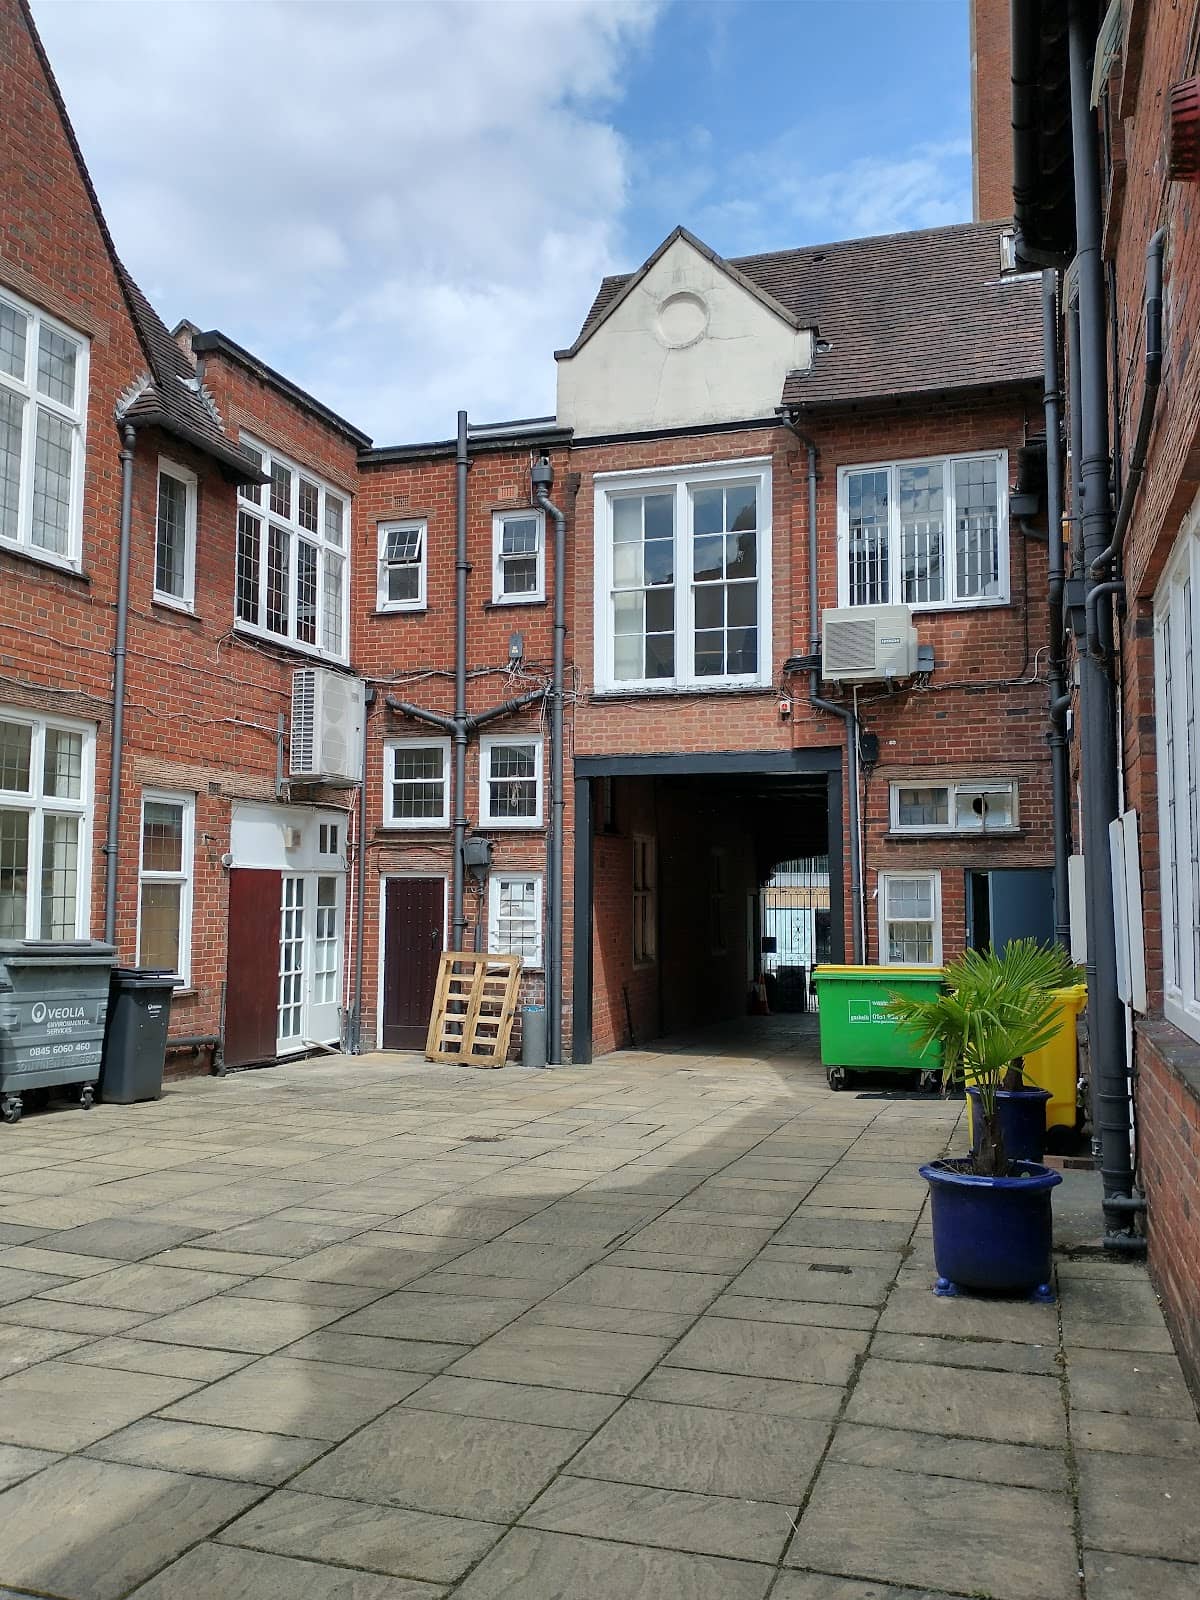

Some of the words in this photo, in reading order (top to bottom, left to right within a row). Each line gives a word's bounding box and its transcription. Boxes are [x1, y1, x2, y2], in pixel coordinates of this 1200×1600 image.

[48, 1007, 85, 1019] VEOLIA
[46, 1027, 73, 1035] SERVICES
[30, 1046, 51, 1057] 0845
[53, 1044, 74, 1054] 6060
[75, 1042, 90, 1051] 460
